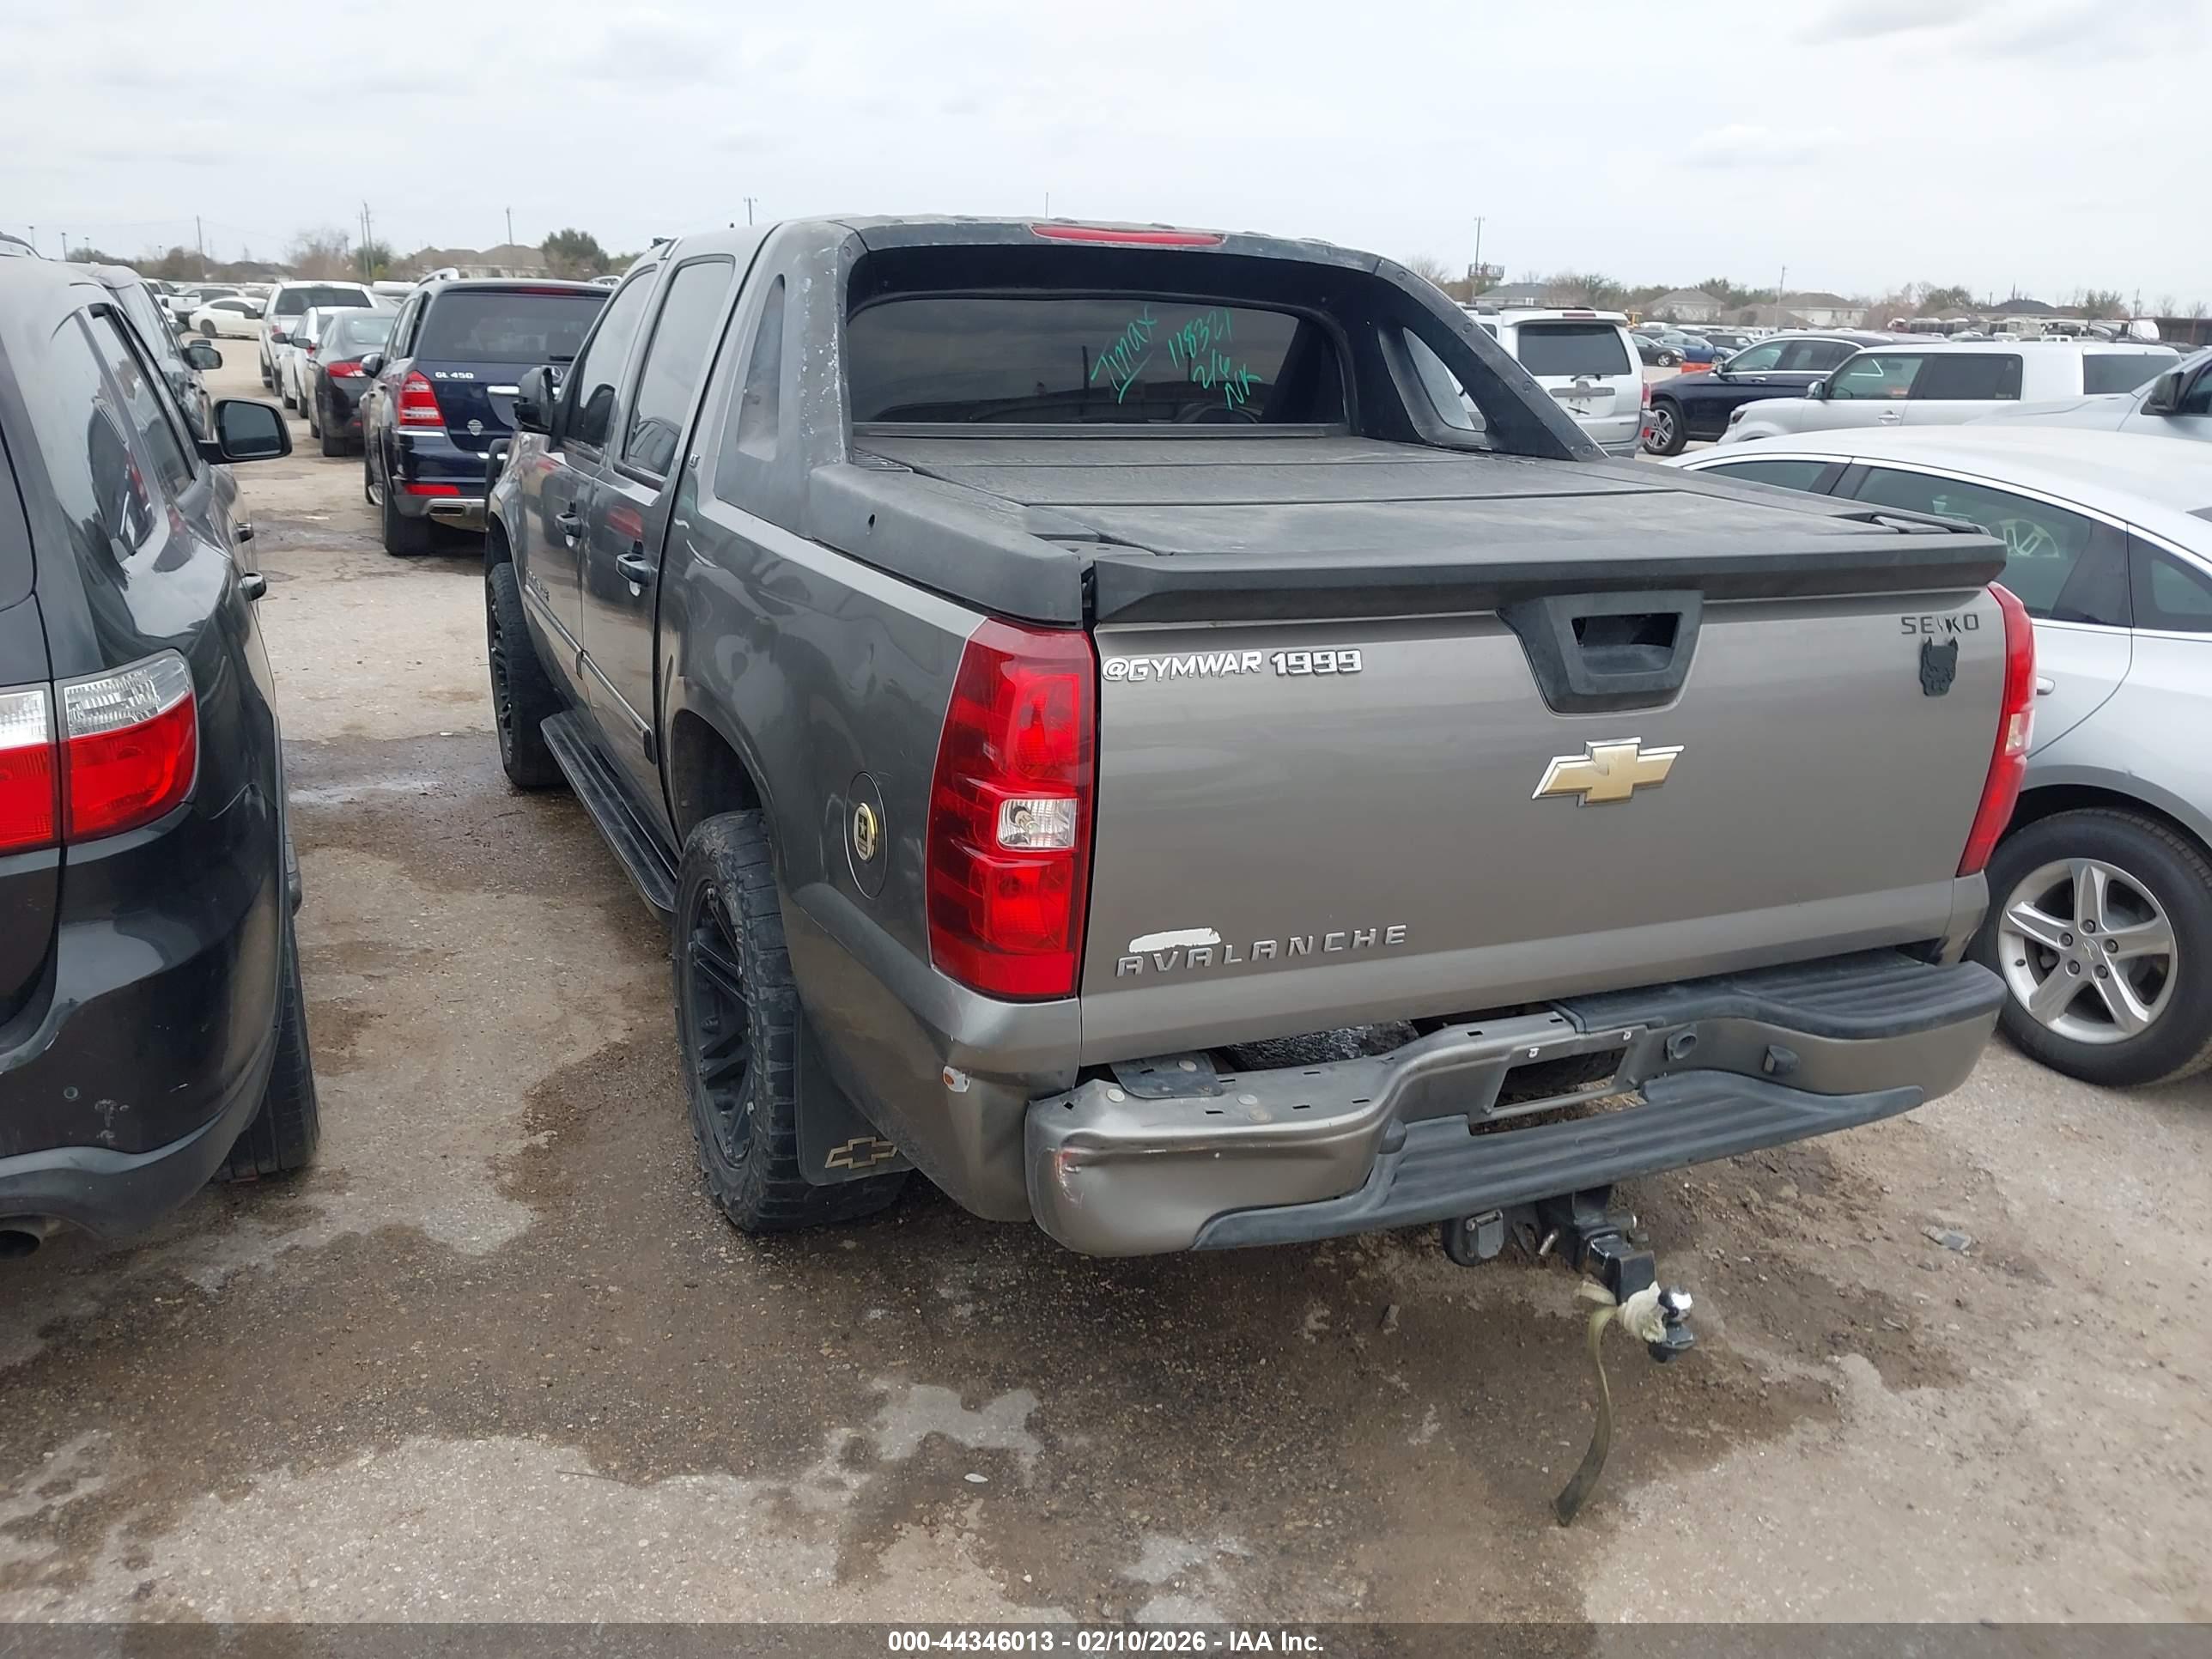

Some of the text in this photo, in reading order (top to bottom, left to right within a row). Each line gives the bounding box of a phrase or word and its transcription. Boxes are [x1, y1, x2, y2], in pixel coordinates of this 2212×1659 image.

[450, 371, 474, 380] 450
[1102, 649, 1363, 682] @GYMWAR 1999
[1115, 924, 1408, 978] AVALANCHE
